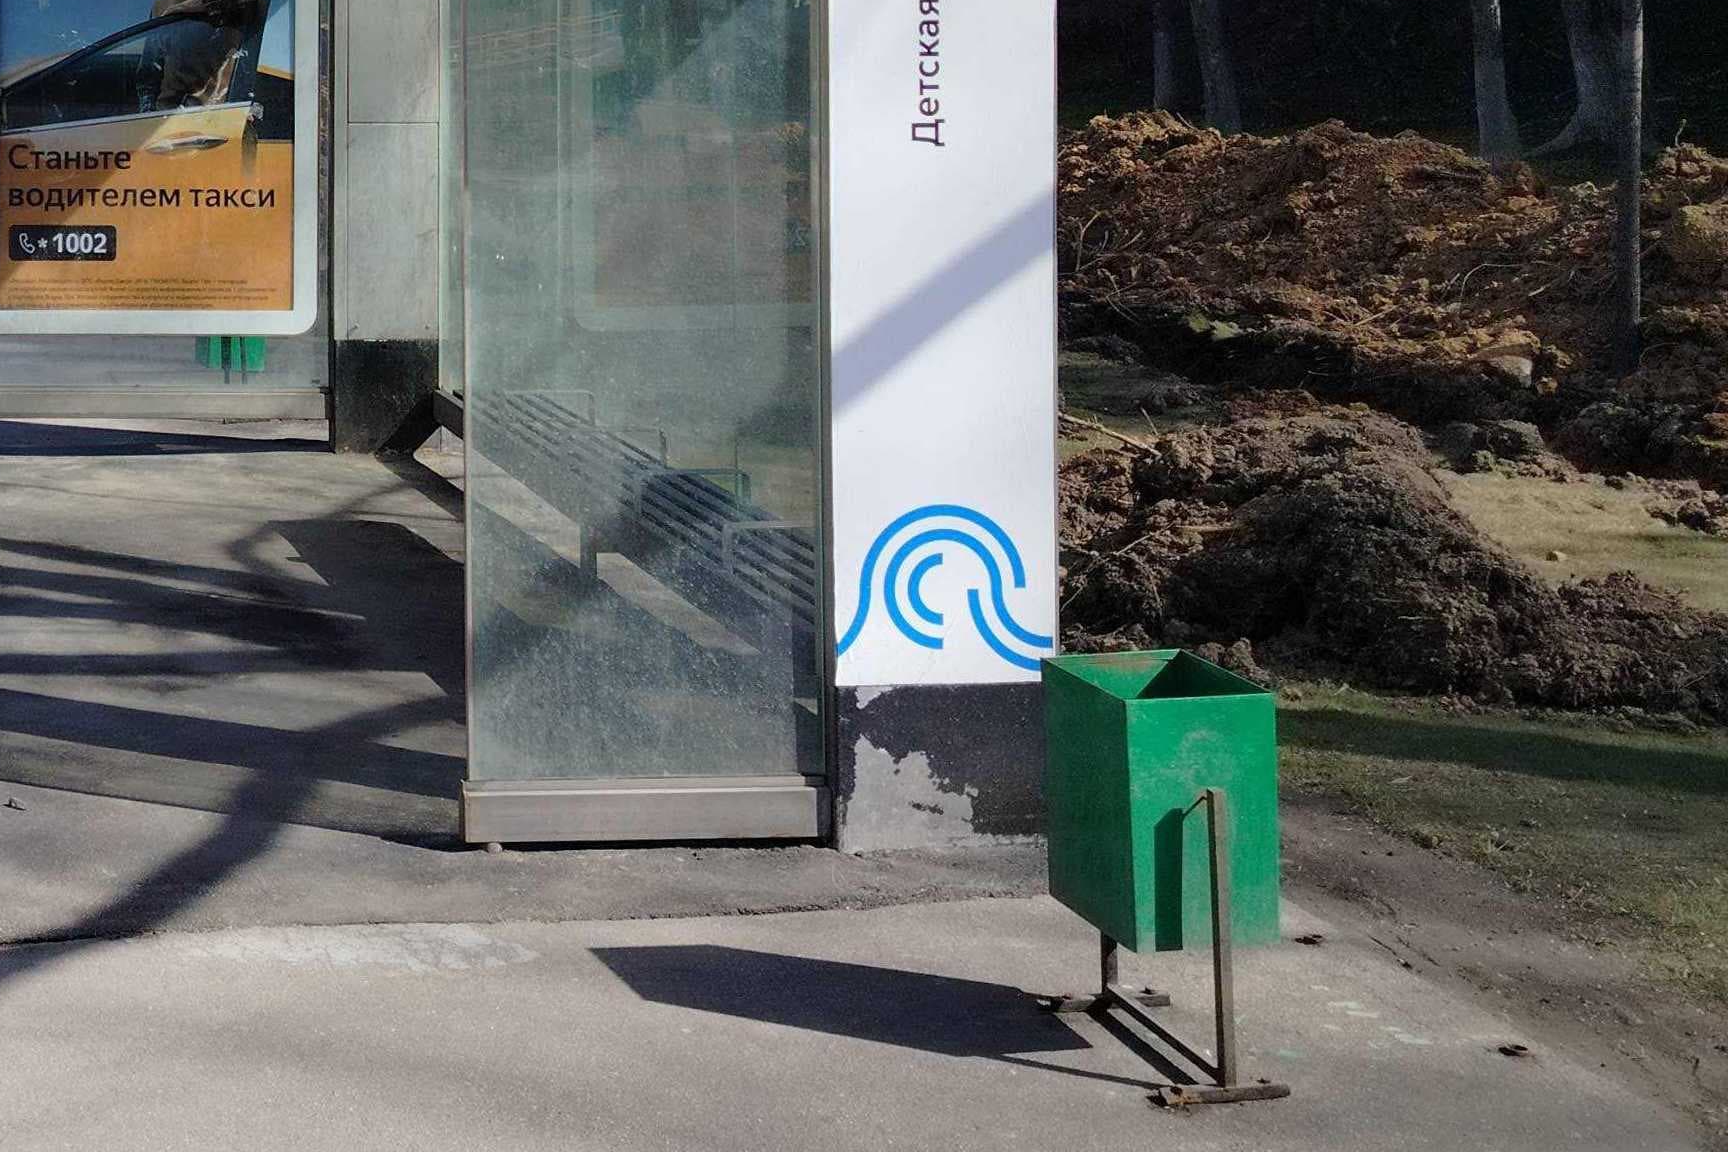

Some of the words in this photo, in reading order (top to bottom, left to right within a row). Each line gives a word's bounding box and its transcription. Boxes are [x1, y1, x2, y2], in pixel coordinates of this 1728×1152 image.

[9, 144, 132, 171] Станьте
[9, 187, 180, 211] водителем
[189, 188, 275, 208] такси
